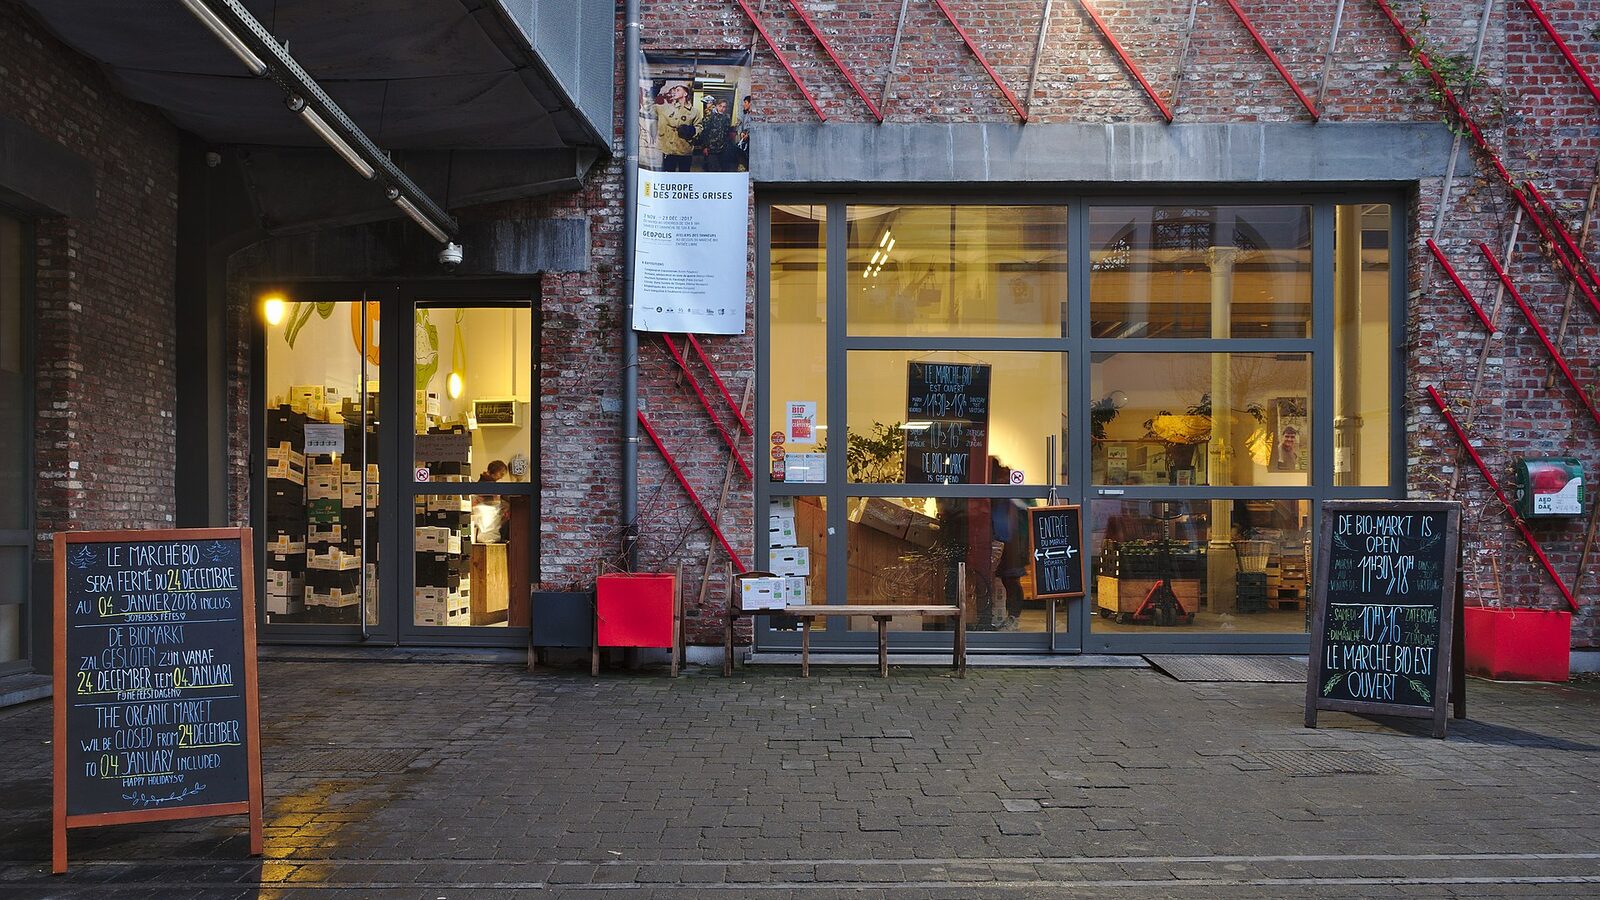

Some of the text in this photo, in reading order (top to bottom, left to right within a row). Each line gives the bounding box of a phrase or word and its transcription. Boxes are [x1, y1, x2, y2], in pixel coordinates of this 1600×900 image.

[653, 183, 694, 191] L'EUROPE
[653, 191, 733, 200] DES ZONES GRISES
[642, 230, 672, 239] GEOPOLIS
[925, 365, 934, 384] LE
[930, 384, 966, 394] EST OUVERT
[1338, 514, 1433, 537] DE BIO-MARKT IS
[106, 542, 200, 568] LE MARCHÉ BIO
[1365, 536, 1400, 554] OPEN
[85, 567, 237, 593] SERA FERMÉ DU 24 DÉCEMBRE
[75, 600, 92, 614] AU
[98, 596, 113, 616] 04
[120, 593, 171, 612] JANVIER
[171, 592, 198, 611] 2018
[124, 613, 159, 623] JOYEUSES
[108, 625, 184, 647] DE BIOMARKT
[80, 646, 214, 671] ZAL GESLOTEN ZIJN VANAF
[1326, 642, 1434, 675] LE MARCHÉ BIO EST
[77, 671, 93, 692] 24
[98, 668, 151, 691] DECEMBER
[173, 668, 189, 688] 04
[1347, 671, 1398, 701] OUVERT
[95, 700, 212, 728] THE ORGANIC MARKET
[102, 737, 112, 750] BE
[115, 727, 153, 750] CLOSED
[157, 732, 179, 747] FROM
[178, 725, 193, 746] 24
[193, 720, 240, 744] DECEMBER
[85, 761, 97, 777] TO
[100, 754, 119, 777] 04
[121, 749, 174, 775] JANUARY
[122, 774, 178, 788] HAPPY HOLIDAYS
